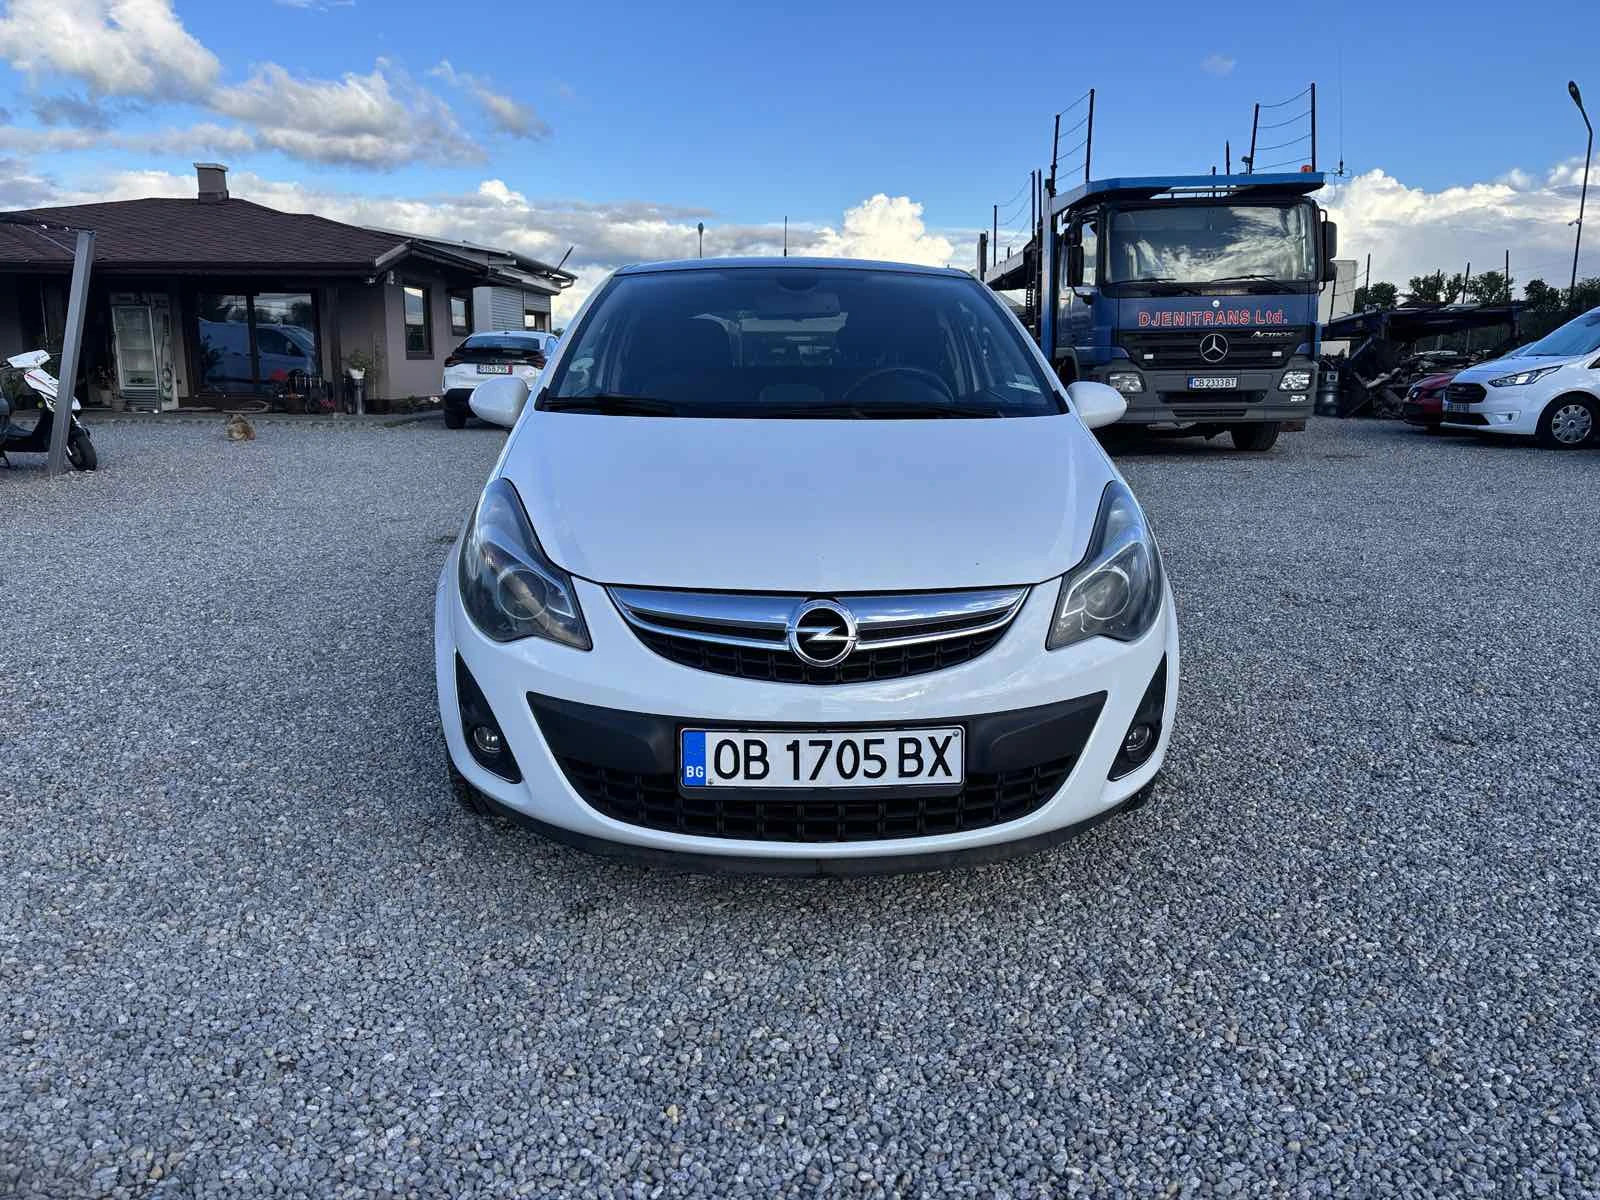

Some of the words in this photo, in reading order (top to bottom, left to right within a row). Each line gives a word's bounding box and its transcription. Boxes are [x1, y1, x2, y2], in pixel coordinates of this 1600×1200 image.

[1138, 309, 1249, 327] DJENITRANS
[1255, 309, 1288, 324] Ltd.
[686, 766, 704, 779] BG
[713, 738, 770, 780] OB
[786, 738, 887, 781] 1705
[897, 735, 953, 778] BX
